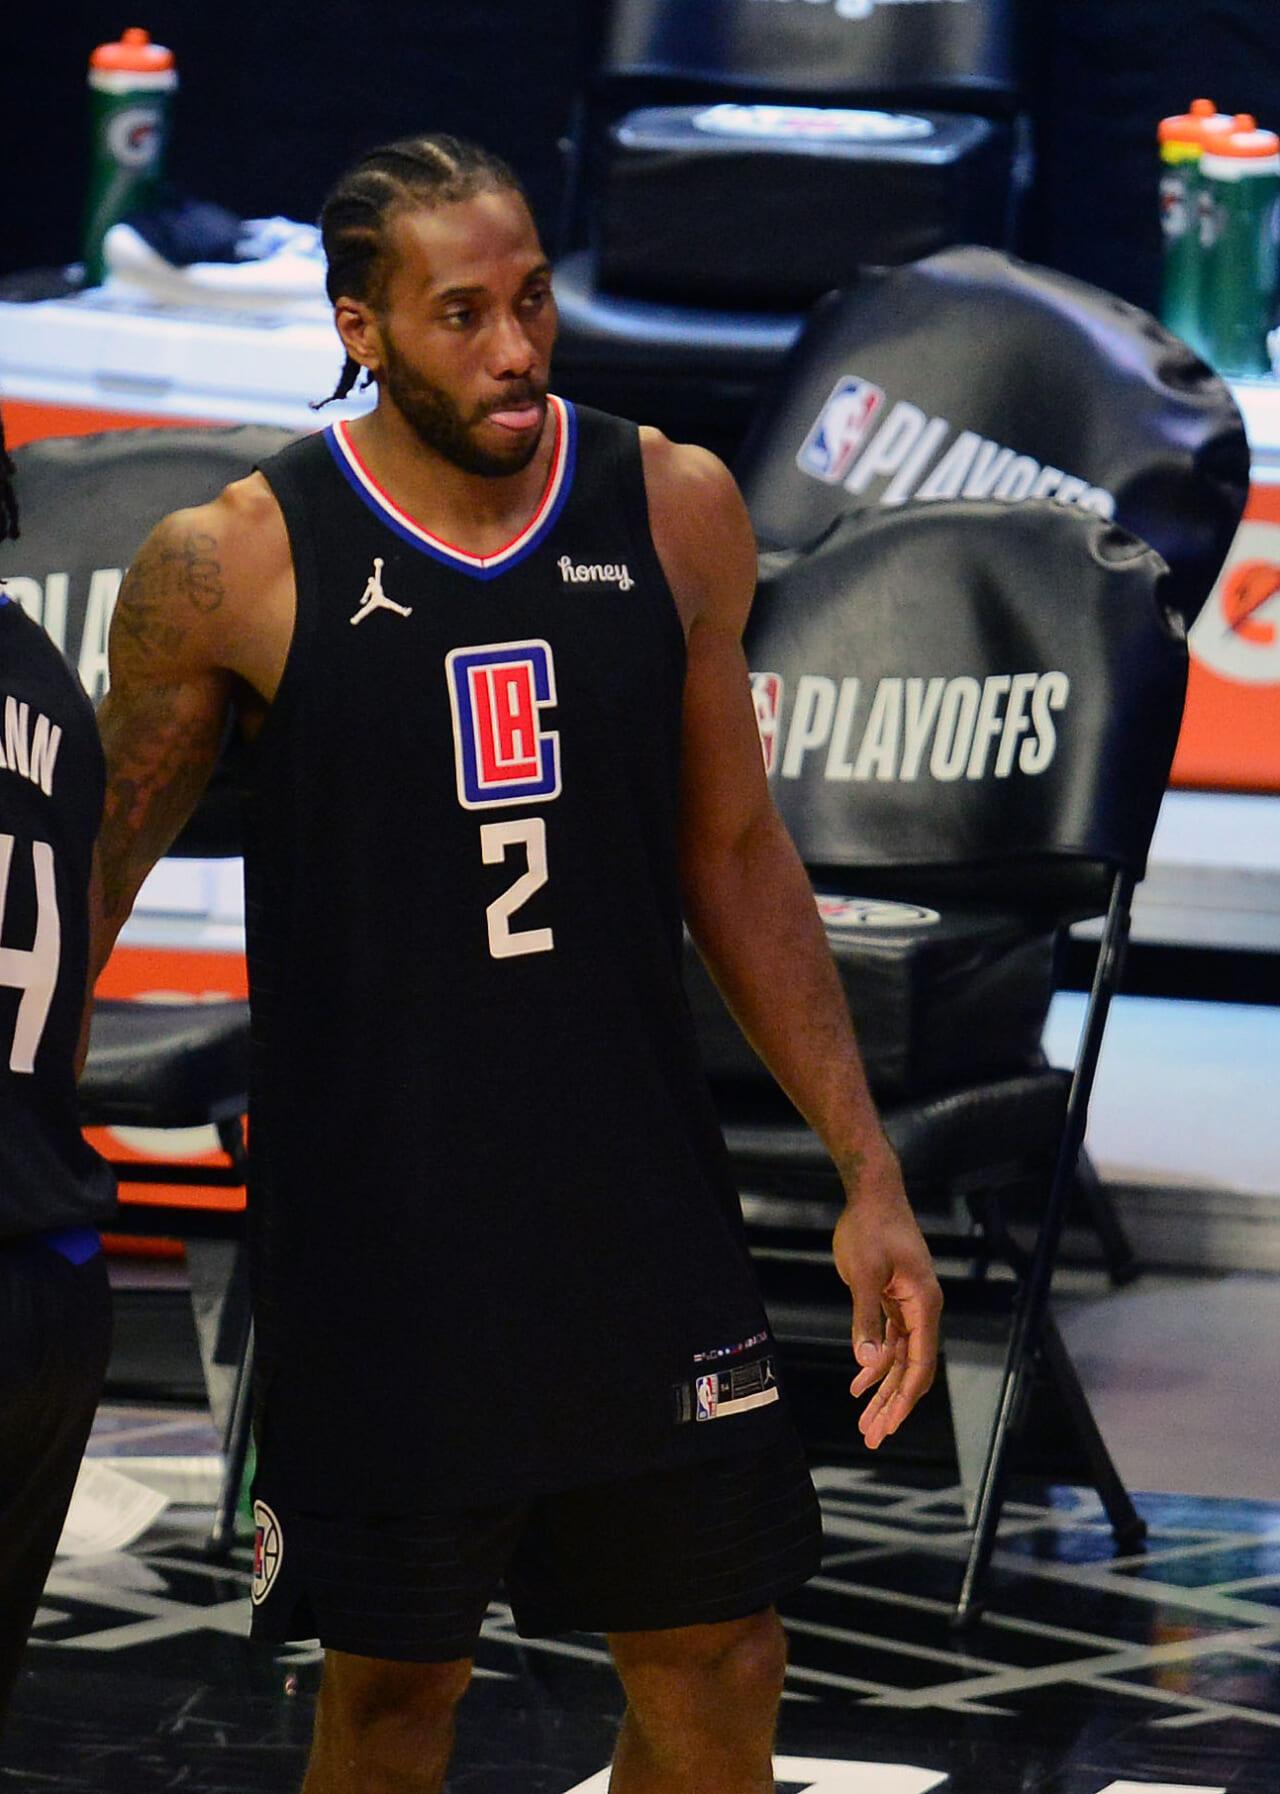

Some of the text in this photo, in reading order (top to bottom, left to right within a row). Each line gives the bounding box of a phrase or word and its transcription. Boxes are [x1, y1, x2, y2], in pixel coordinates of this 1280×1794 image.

[557, 555, 634, 591] honey
[781, 671, 1070, 782] PLAYOFFS
[480, 817, 554, 959] 2
